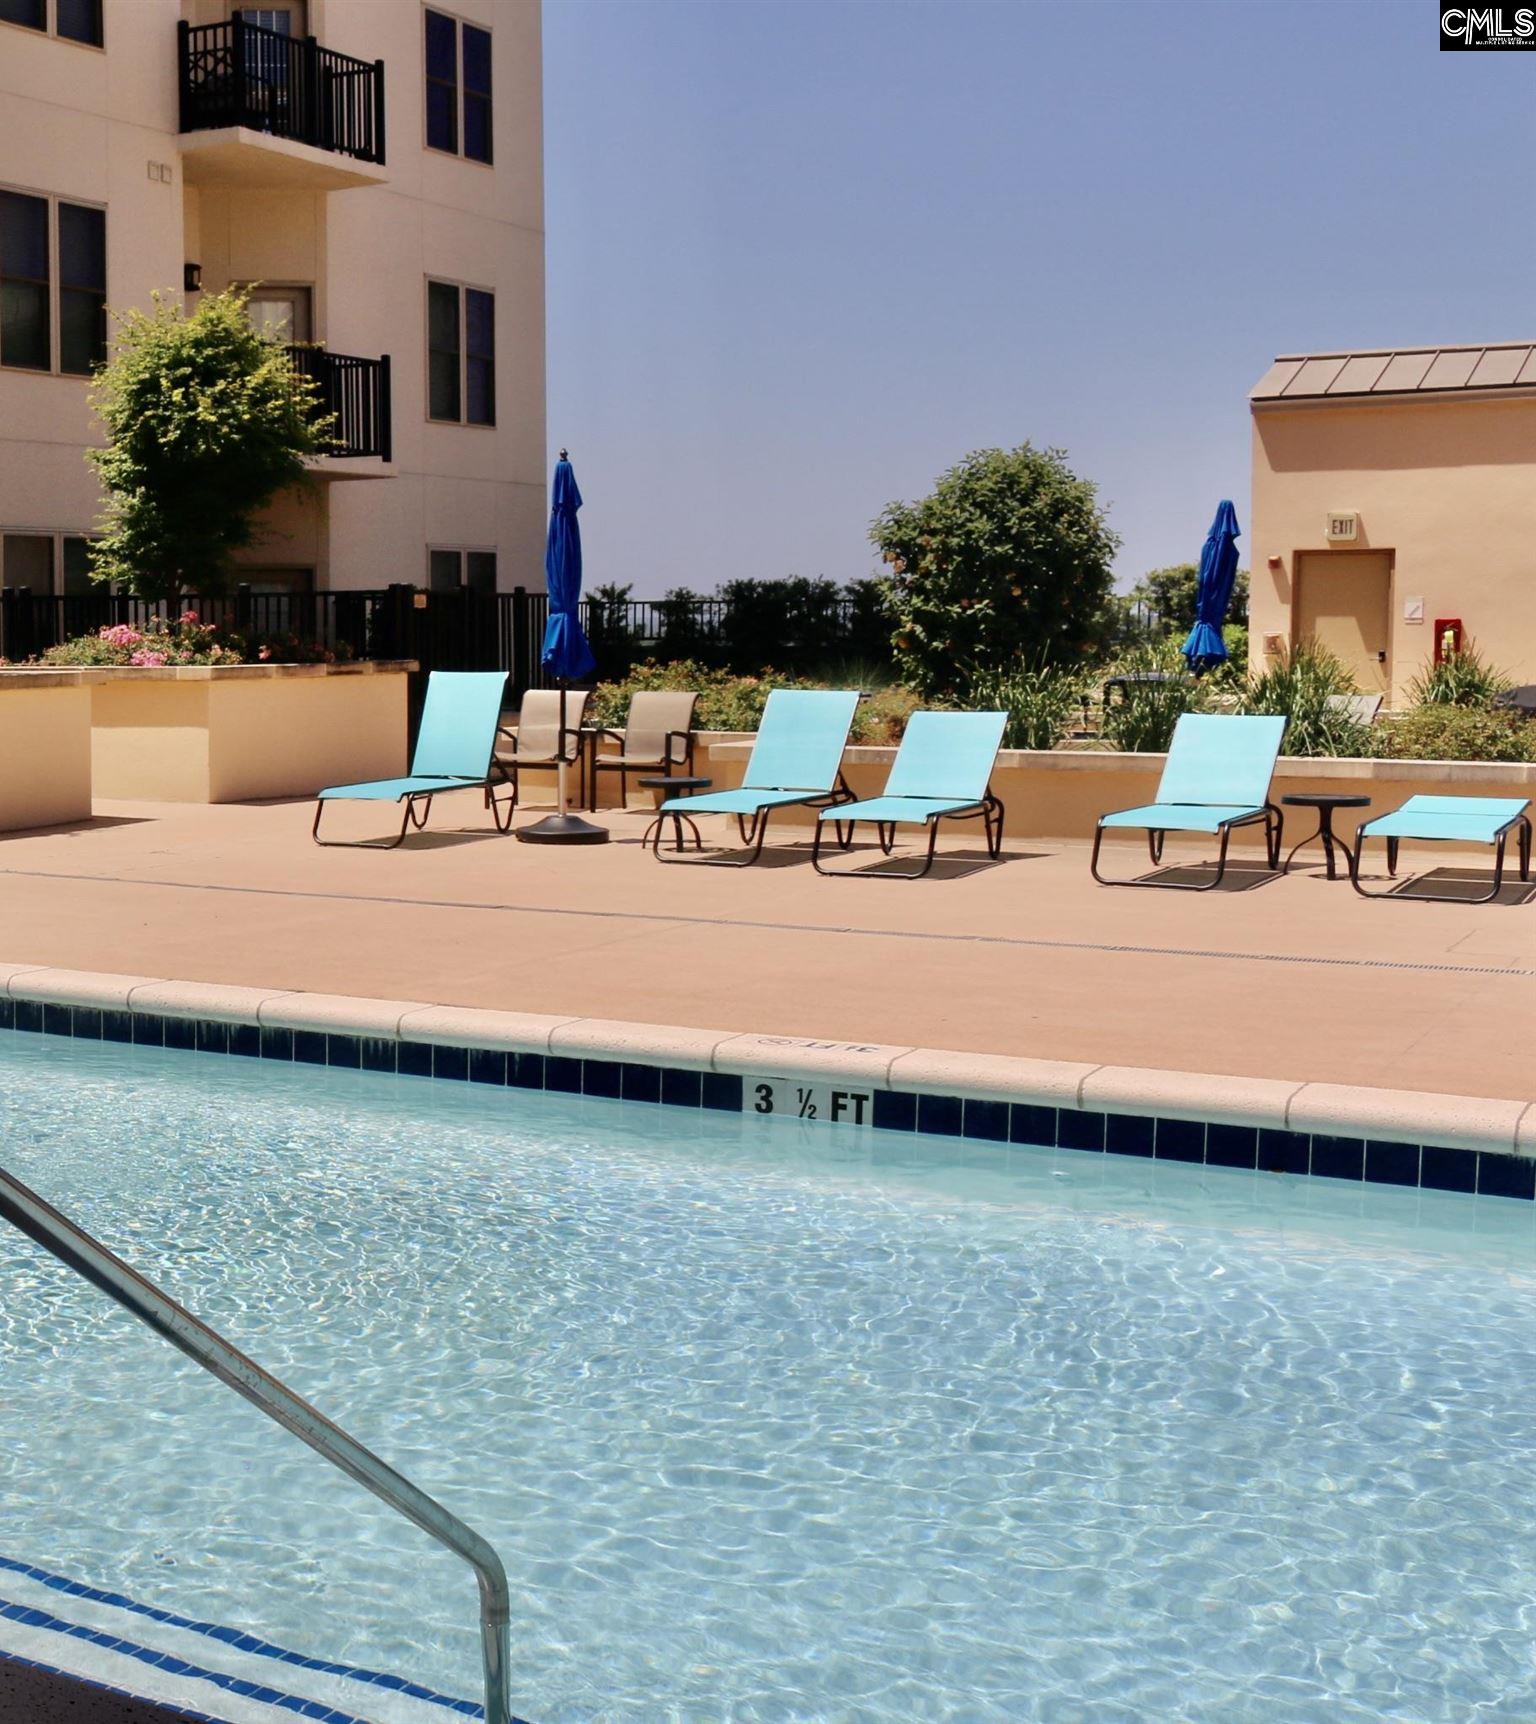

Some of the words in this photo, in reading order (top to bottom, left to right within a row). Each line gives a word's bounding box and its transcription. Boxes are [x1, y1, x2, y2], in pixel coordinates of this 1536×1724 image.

[1332, 519, 1354, 535] EXIT
[754, 1083, 774, 1114] 3
[830, 1090, 870, 1125] FT
